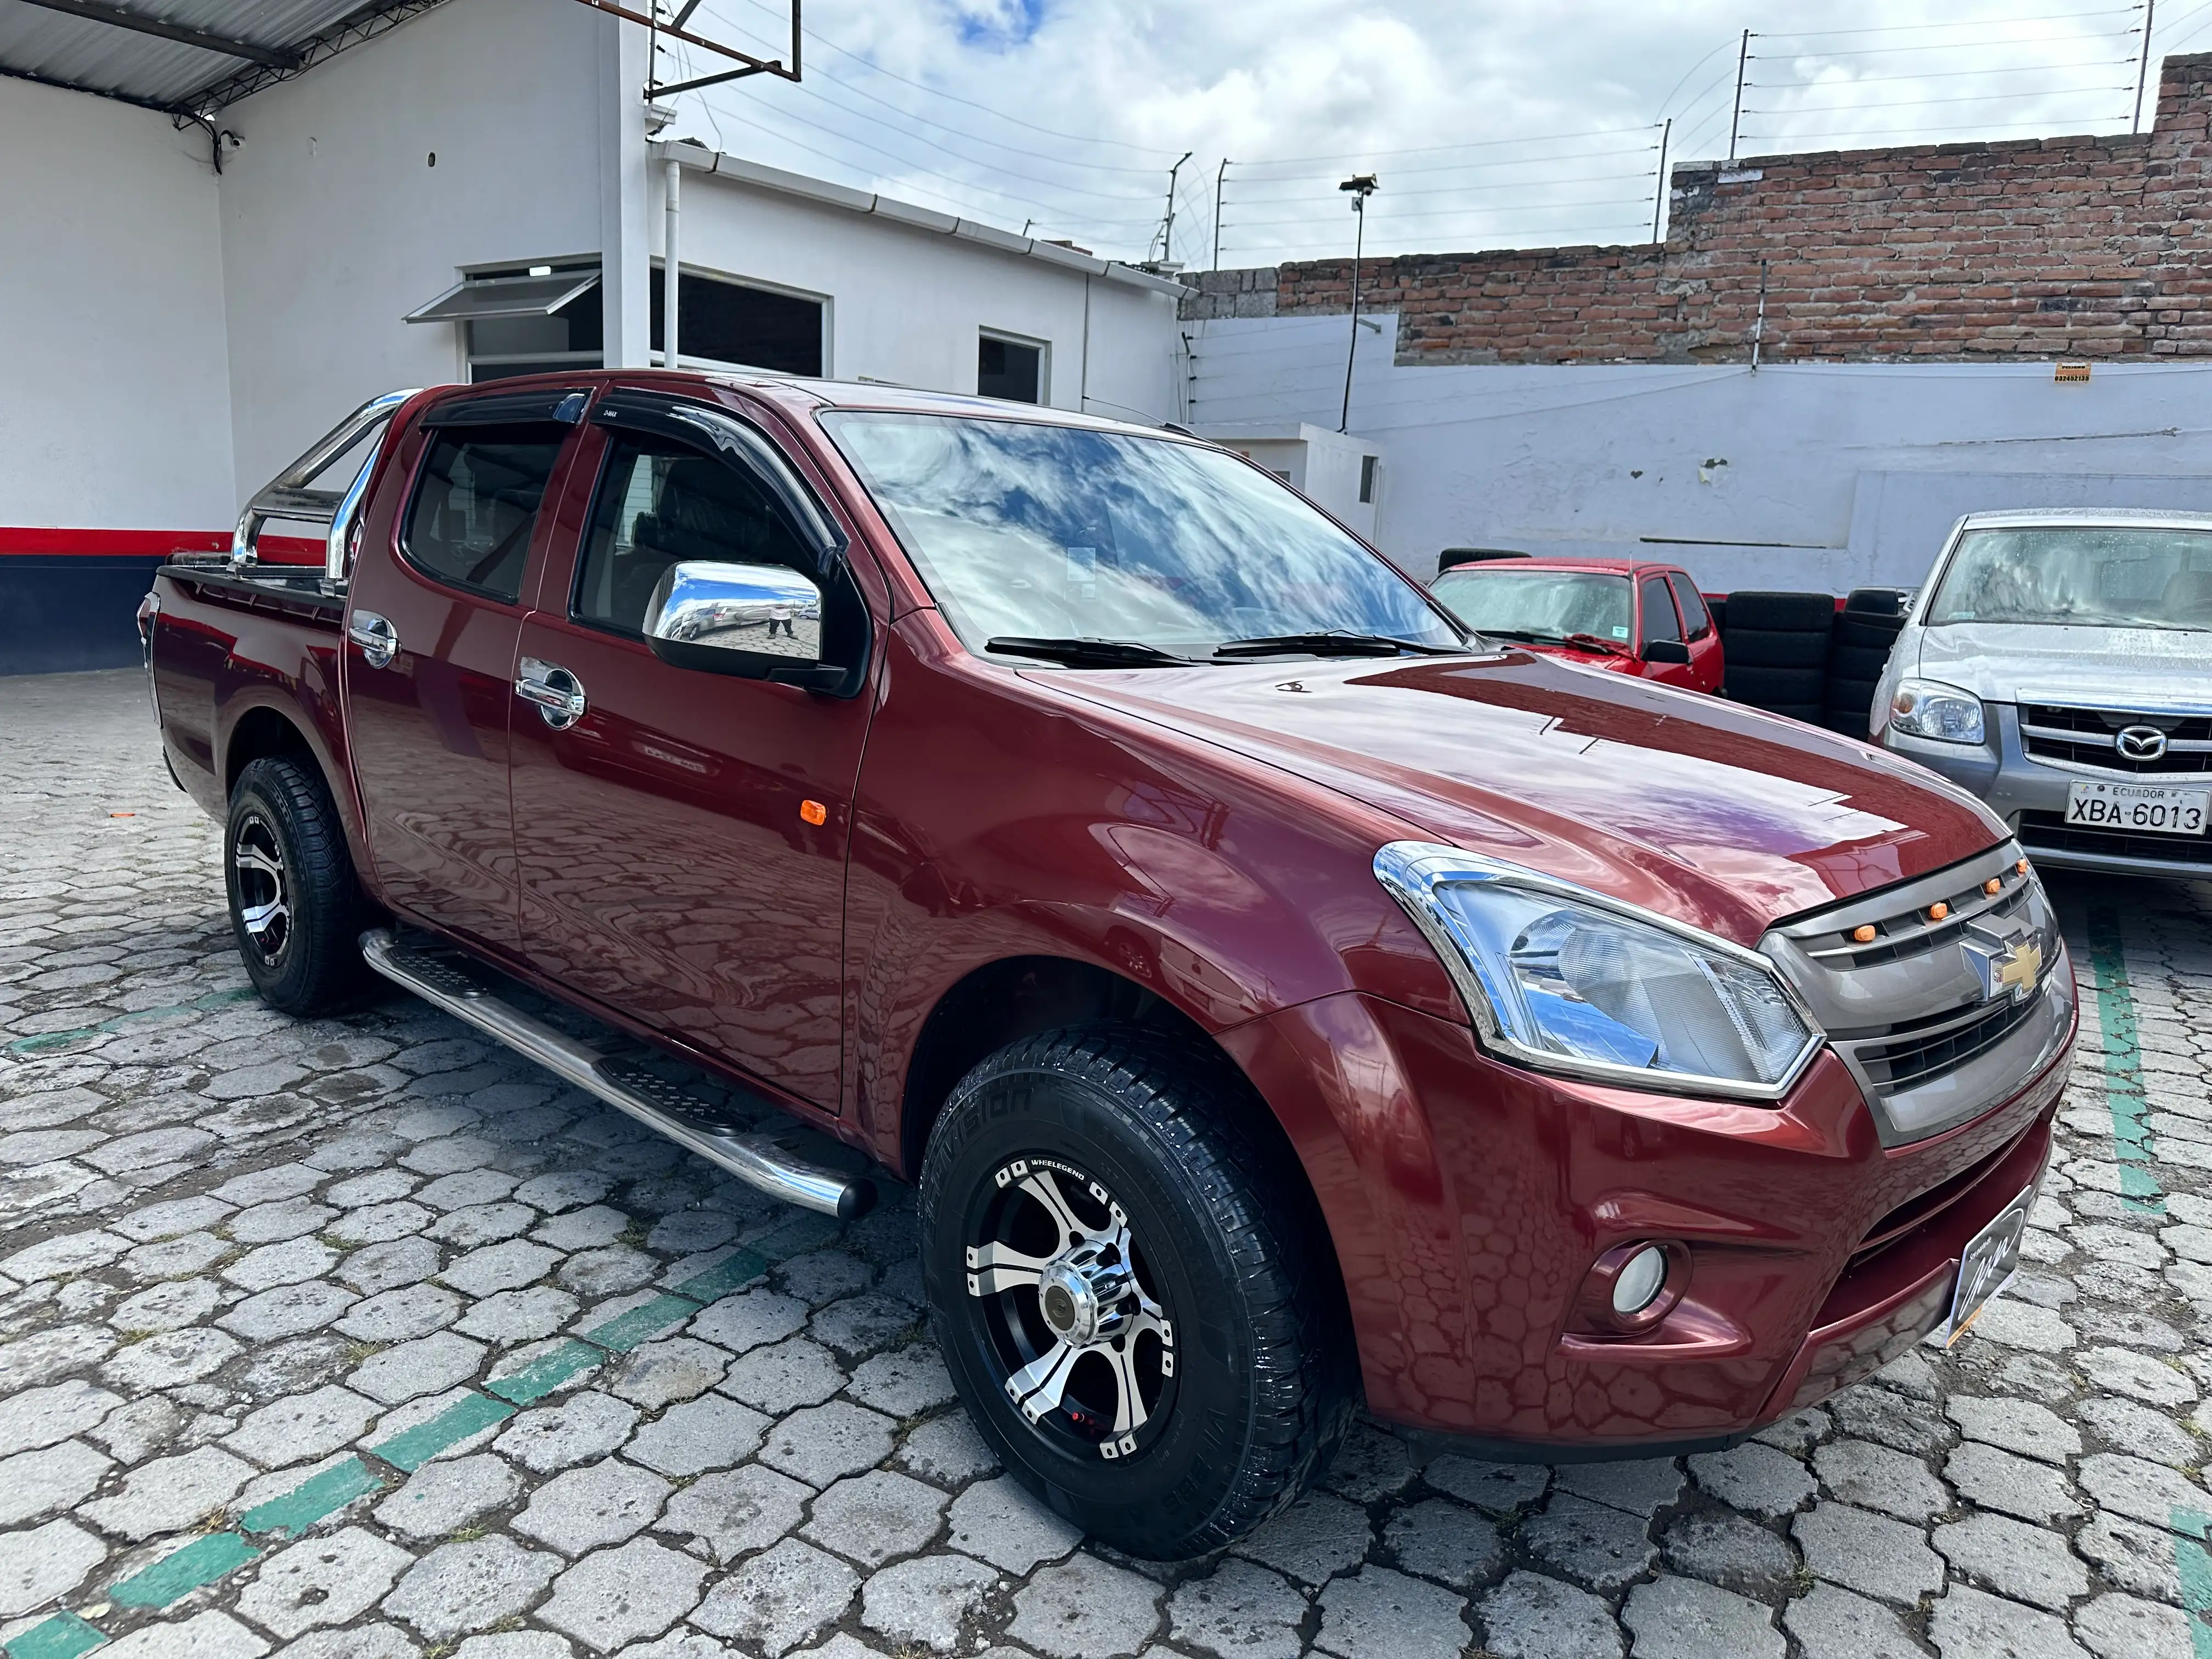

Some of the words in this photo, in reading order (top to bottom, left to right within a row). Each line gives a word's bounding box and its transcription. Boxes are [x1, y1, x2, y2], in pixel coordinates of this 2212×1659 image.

[2113, 787, 2164, 799] ECUADOR
[2072, 798, 2201, 830] XBA-6013
[1031, 1159, 1085, 1181] WHEELEGEND
